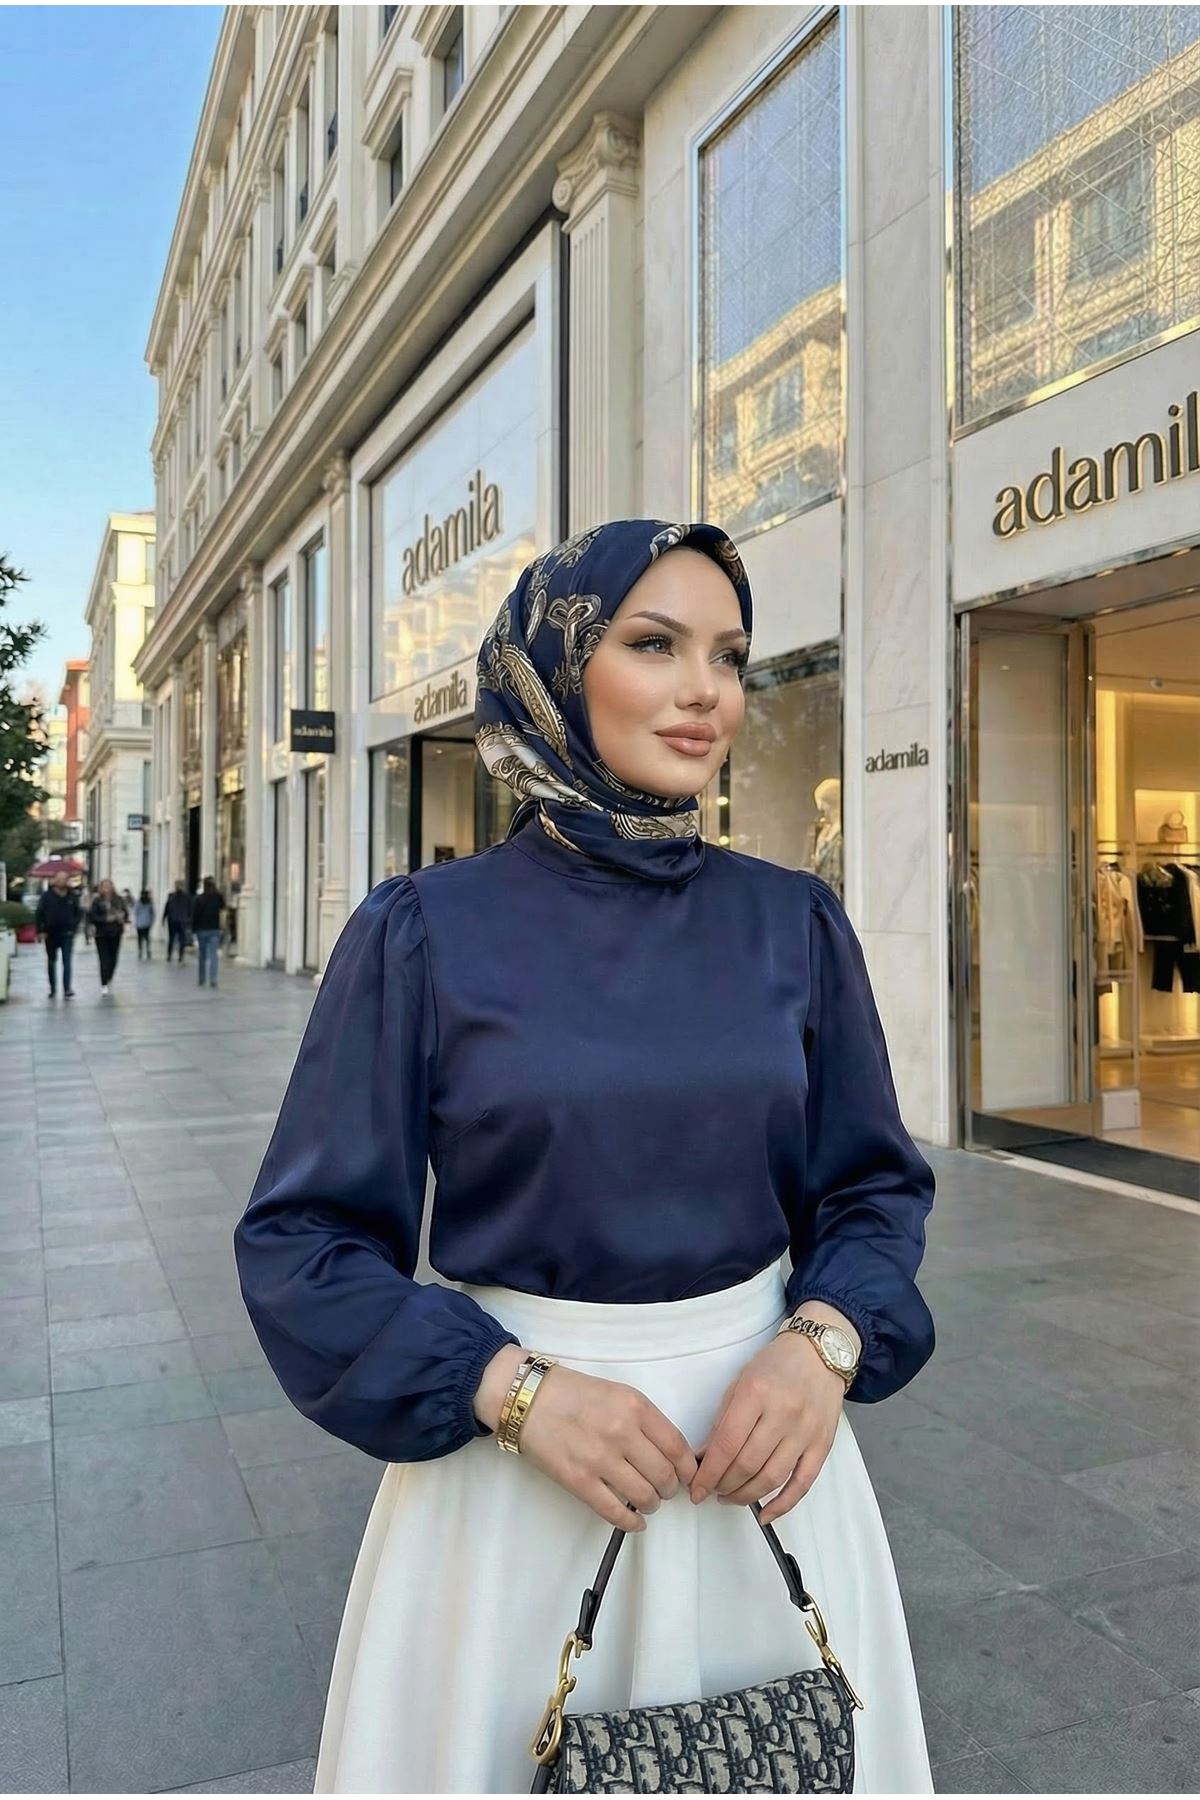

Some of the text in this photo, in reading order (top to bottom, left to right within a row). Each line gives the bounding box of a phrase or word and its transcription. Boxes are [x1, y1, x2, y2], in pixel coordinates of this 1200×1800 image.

[993, 390, 1200, 539] adamil
[403, 469, 501, 595] adamila
[414, 670, 467, 724] adamila
[865, 742, 929, 773] adamila
